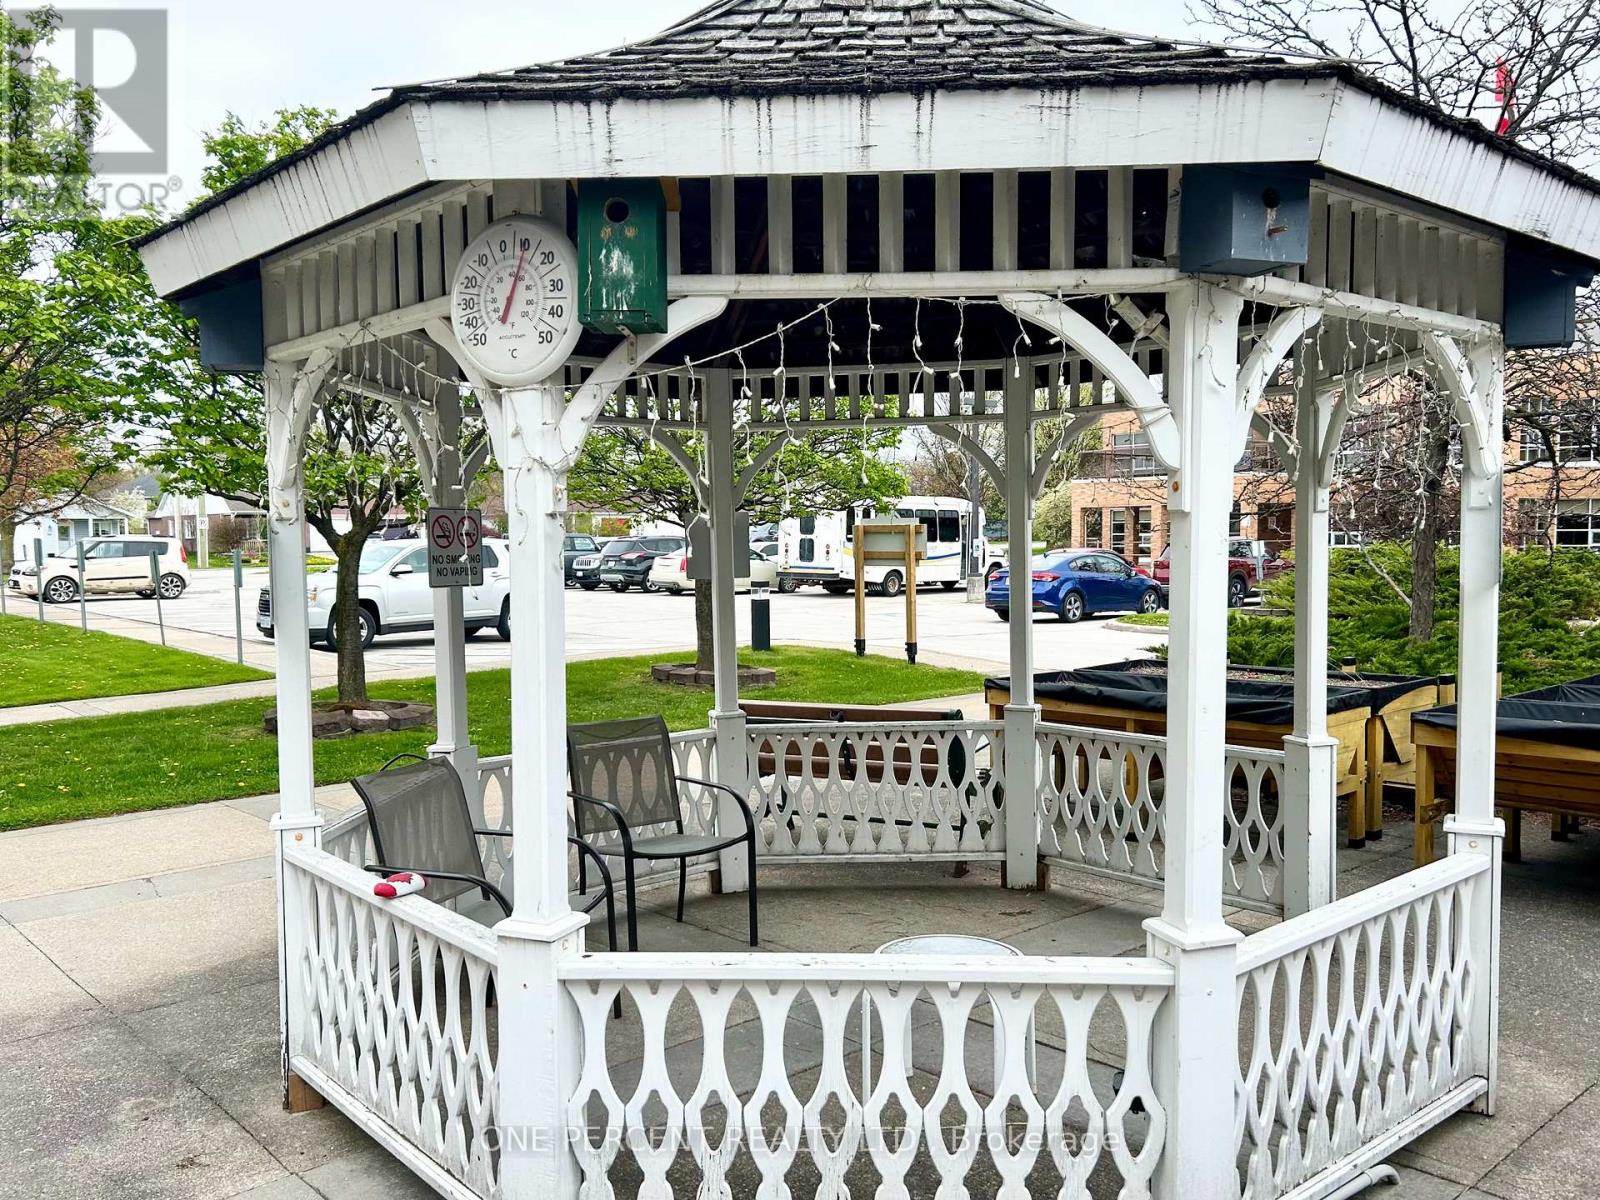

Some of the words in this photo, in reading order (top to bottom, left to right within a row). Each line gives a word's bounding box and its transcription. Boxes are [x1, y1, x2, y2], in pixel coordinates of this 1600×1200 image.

[499, 239, 507, 253] 0
[519, 238, 530, 252] 10
[473, 253, 488, 267] -10
[540, 250, 554, 265] 20
[460, 275, 478, 290] -20
[549, 278, 563, 293] 30
[457, 297, 475, 311] -30
[547, 304, 563, 318] 40
[459, 316, 478, 330] -40
[468, 333, 487, 346] -50
[538, 330, 553, 345] 50
[432, 555, 444, 564] NO
[436, 567, 448, 576] NO
